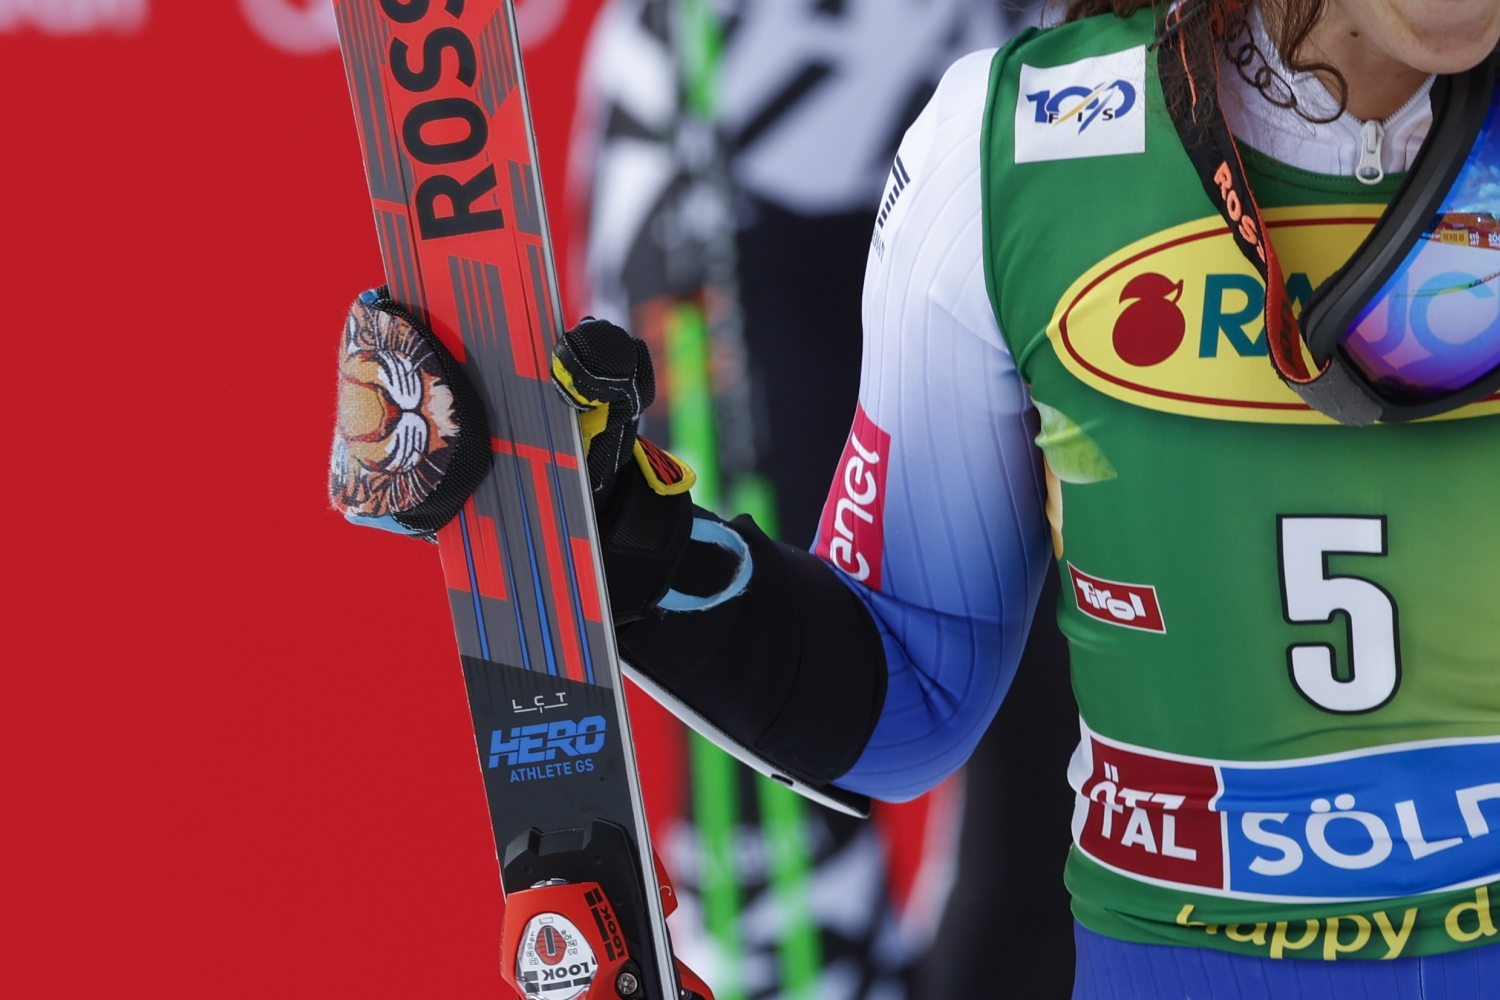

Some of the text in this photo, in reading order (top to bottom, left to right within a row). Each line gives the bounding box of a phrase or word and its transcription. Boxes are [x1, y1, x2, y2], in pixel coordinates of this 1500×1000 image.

[829, 431, 880, 582] enel
[1076, 577, 1147, 621] Tirol
[1276, 514, 1401, 716] 5
[488, 714, 607, 770] HERO
[510, 758, 595, 783] ATHLETE GS
[1101, 802, 1197, 862] TAL
[600, 905, 626, 958] LOOK
[541, 962, 590, 981] LOOK
